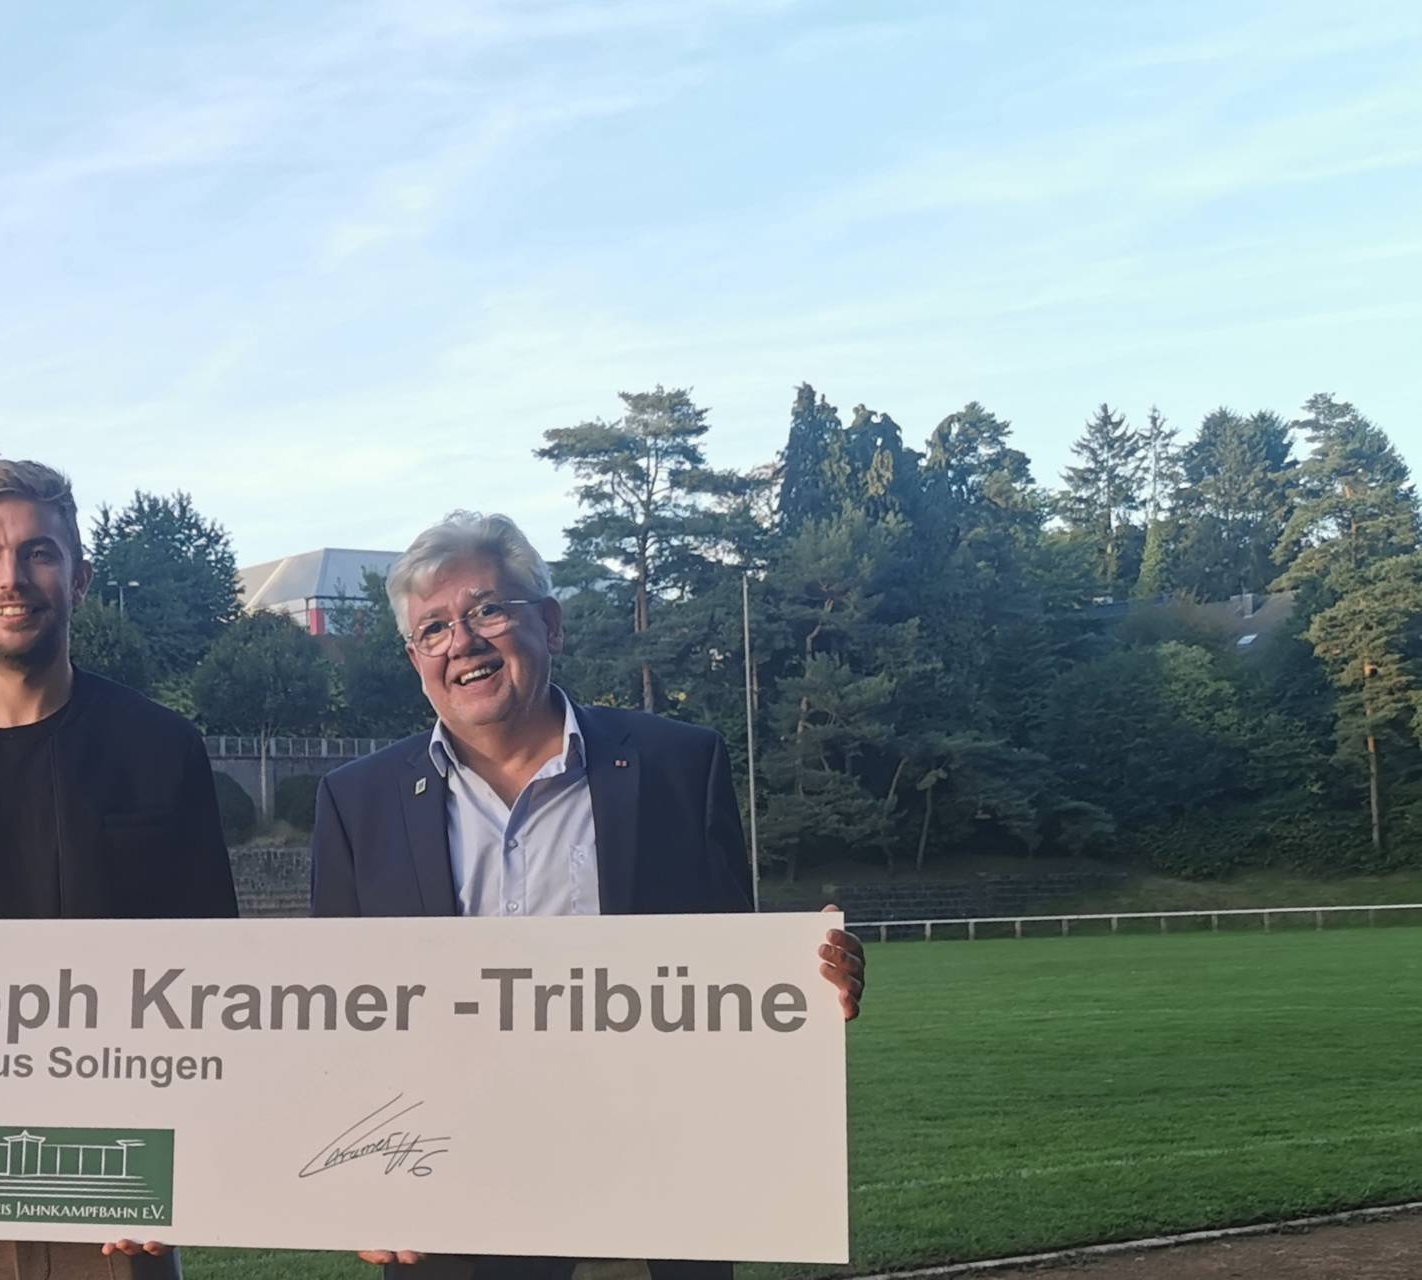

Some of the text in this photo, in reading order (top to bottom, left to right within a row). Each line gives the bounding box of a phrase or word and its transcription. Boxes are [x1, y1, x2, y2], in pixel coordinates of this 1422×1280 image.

[130, 968, 426, 1032] Kramer
[453, 965, 808, 1033] -Tribüne
[48, 1046, 223, 1088] Solingen
[16, 1200, 139, 1219] JAHNKAMPFBAHN
